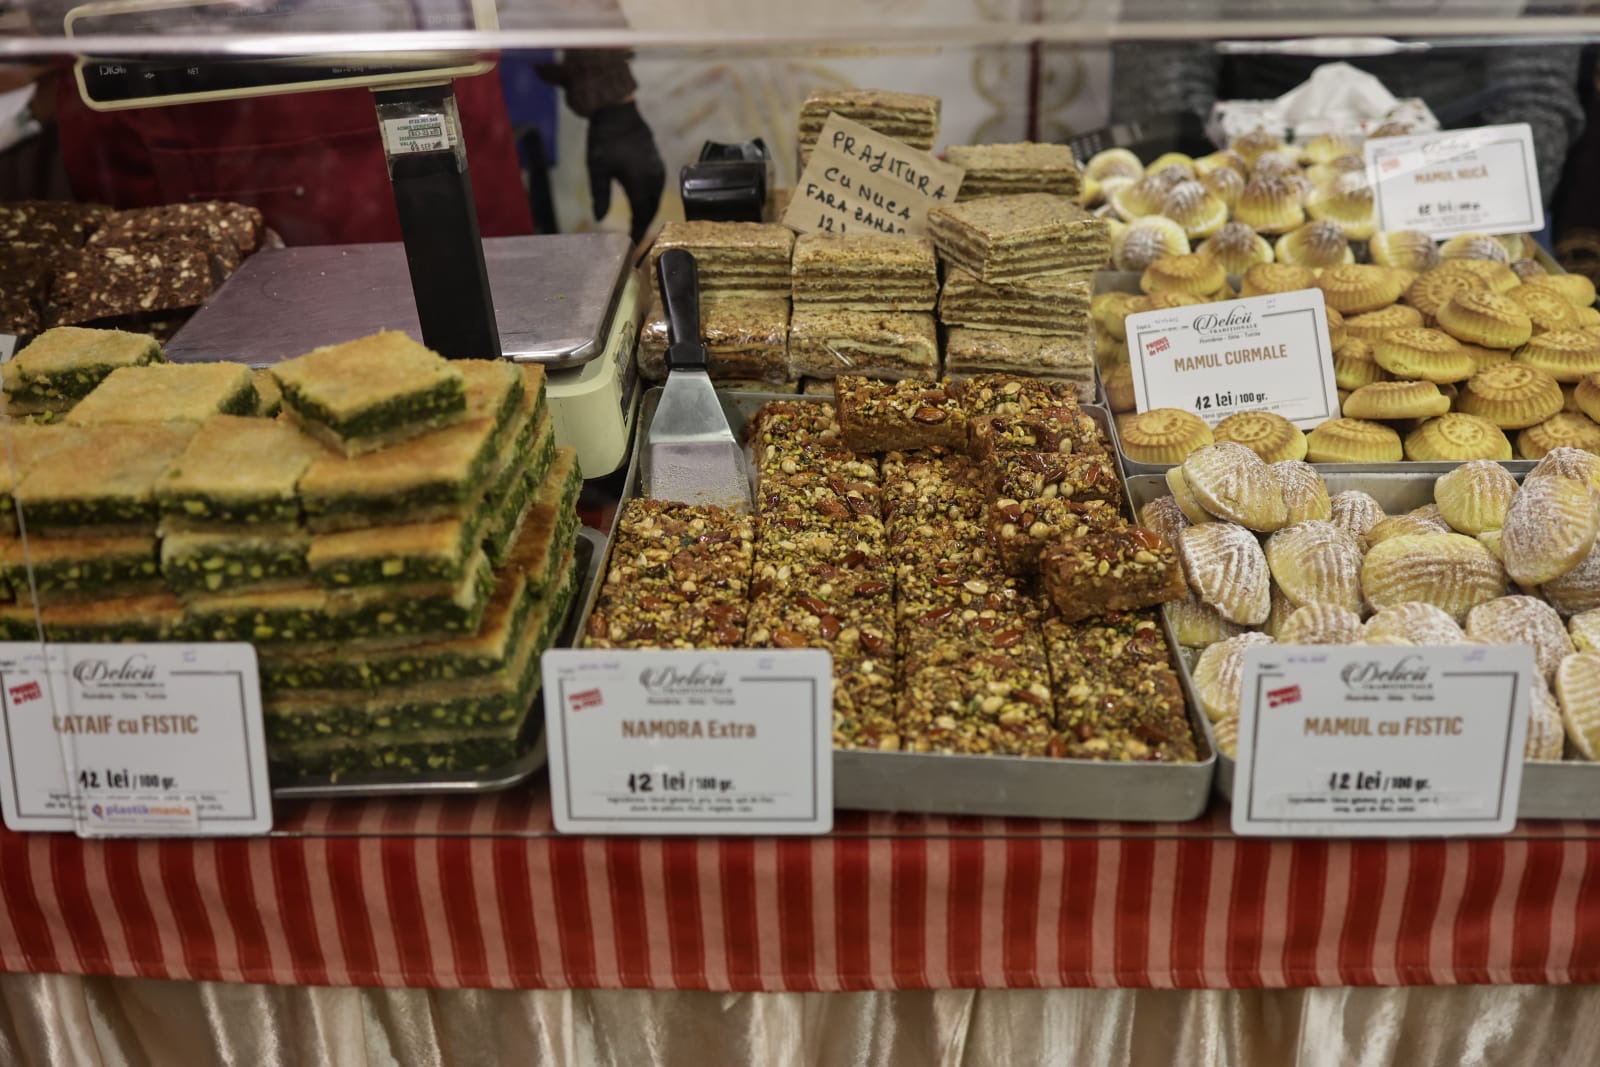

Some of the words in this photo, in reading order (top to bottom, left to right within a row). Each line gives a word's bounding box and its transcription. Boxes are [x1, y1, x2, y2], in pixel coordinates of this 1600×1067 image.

[832, 131, 948, 200] PRAJITURA
[806, 183, 847, 213] FARA
[858, 184, 912, 220] NUCA
[817, 214, 834, 233] 12
[1193, 304, 1253, 335] Delicii
[1174, 354, 1222, 373] MAMUL
[1225, 344, 1288, 365] CURMALE
[1195, 395, 1212, 411] 12
[72, 654, 158, 688] Delicii
[639, 659, 728, 691] Delicii
[1340, 655, 1431, 690] Delicii
[118, 718, 138, 735] cu
[142, 714, 199, 735] FISTIC
[622, 719, 703, 739] NAMORA
[708, 720, 757, 739] Extra
[1304, 717, 1372, 736] MAMUL
[1377, 720, 1400, 736] cu
[1403, 716, 1464, 736] FISTIC
[78, 770, 100, 789] 12
[628, 772, 653, 792] 12
[1328, 772, 1350, 791] 12
